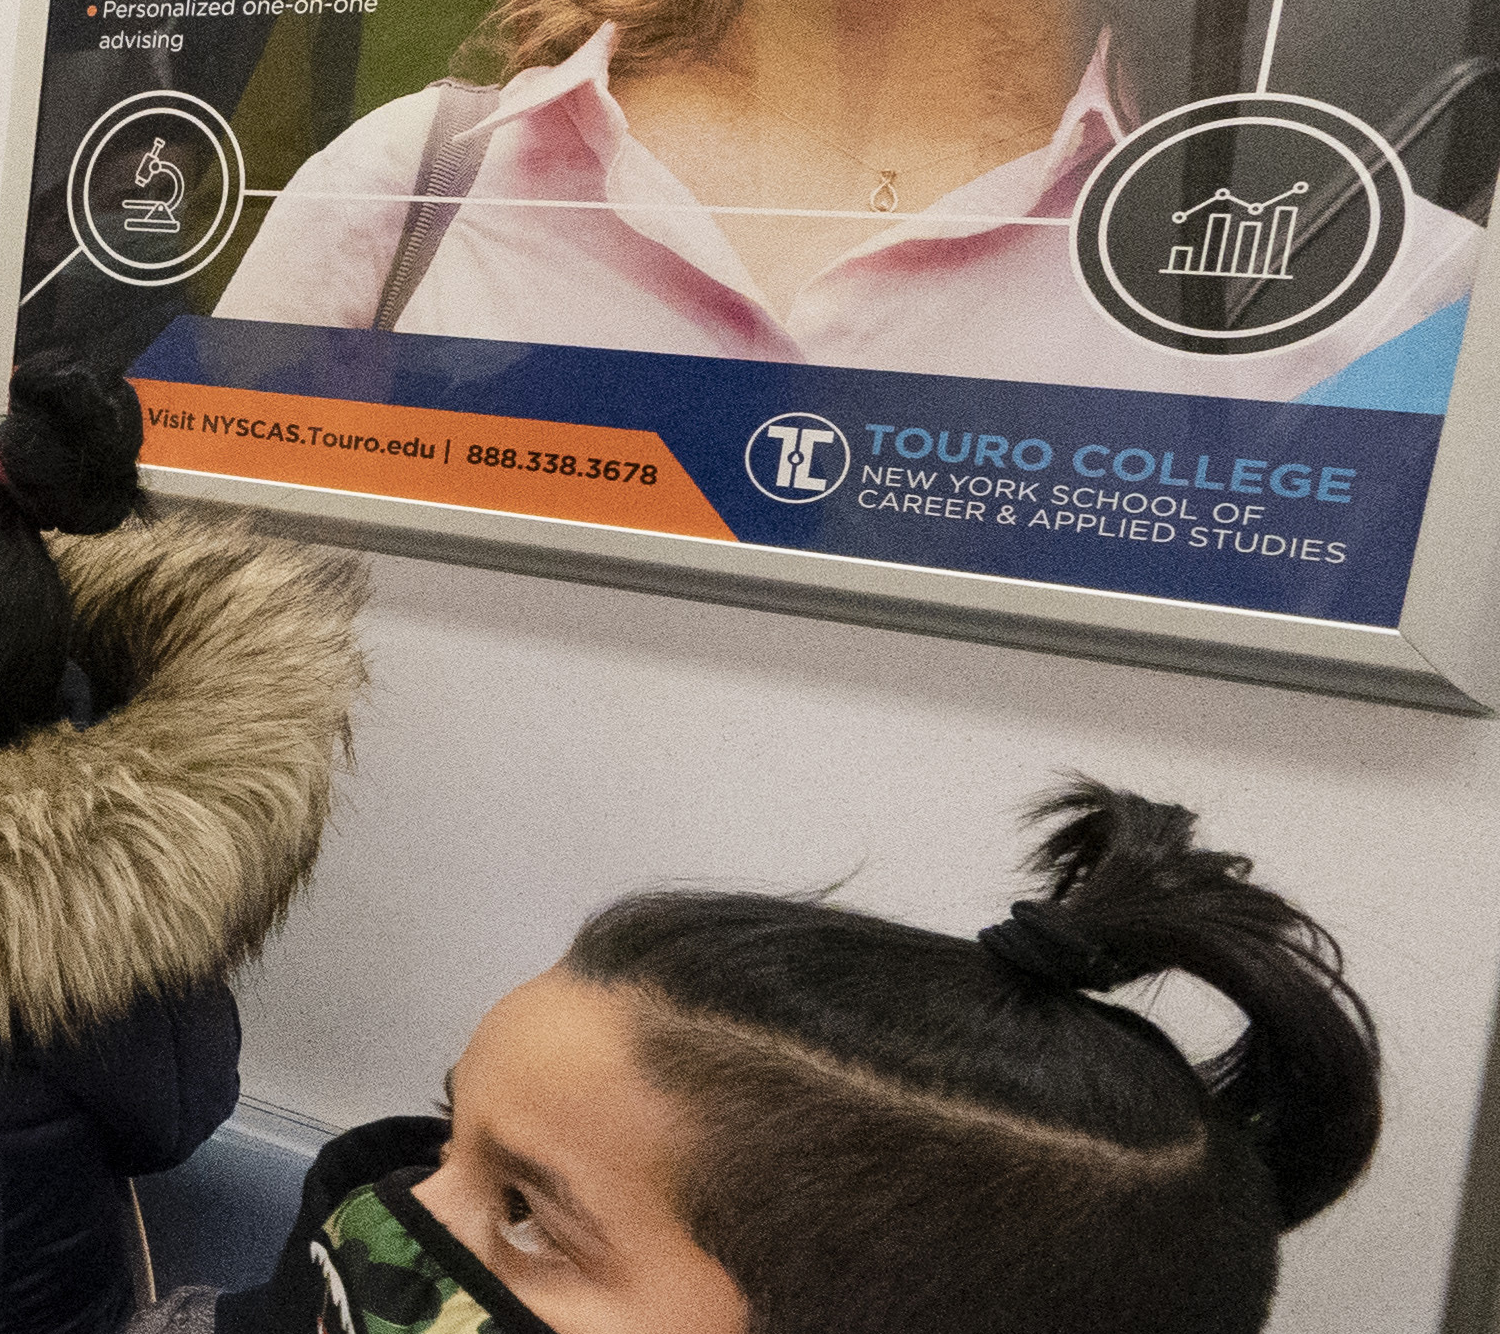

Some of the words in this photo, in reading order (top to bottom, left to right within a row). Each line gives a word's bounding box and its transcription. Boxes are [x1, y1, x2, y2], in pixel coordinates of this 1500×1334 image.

[98, 28, 185, 53] advising
[147, 407, 196, 433] Visit
[202, 414, 436, 460] NYSCAS.Touro.edu
[466, 444, 658, 487] 888.338.3678
[864, 423, 1053, 472] TOURO
[1073, 444, 1357, 504] COLLEGE
[857, 489, 985, 522] CAREER
[996, 506, 1017, 524] &
[1027, 509, 1176, 544] APPLIED
[1188, 526, 1348, 564] STUDIES
[860, 464, 938, 489] NEW
[949, 475, 1038, 503] YORK
[1051, 484, 1197, 521] SCHOOL
[1213, 503, 1266, 526] OF
